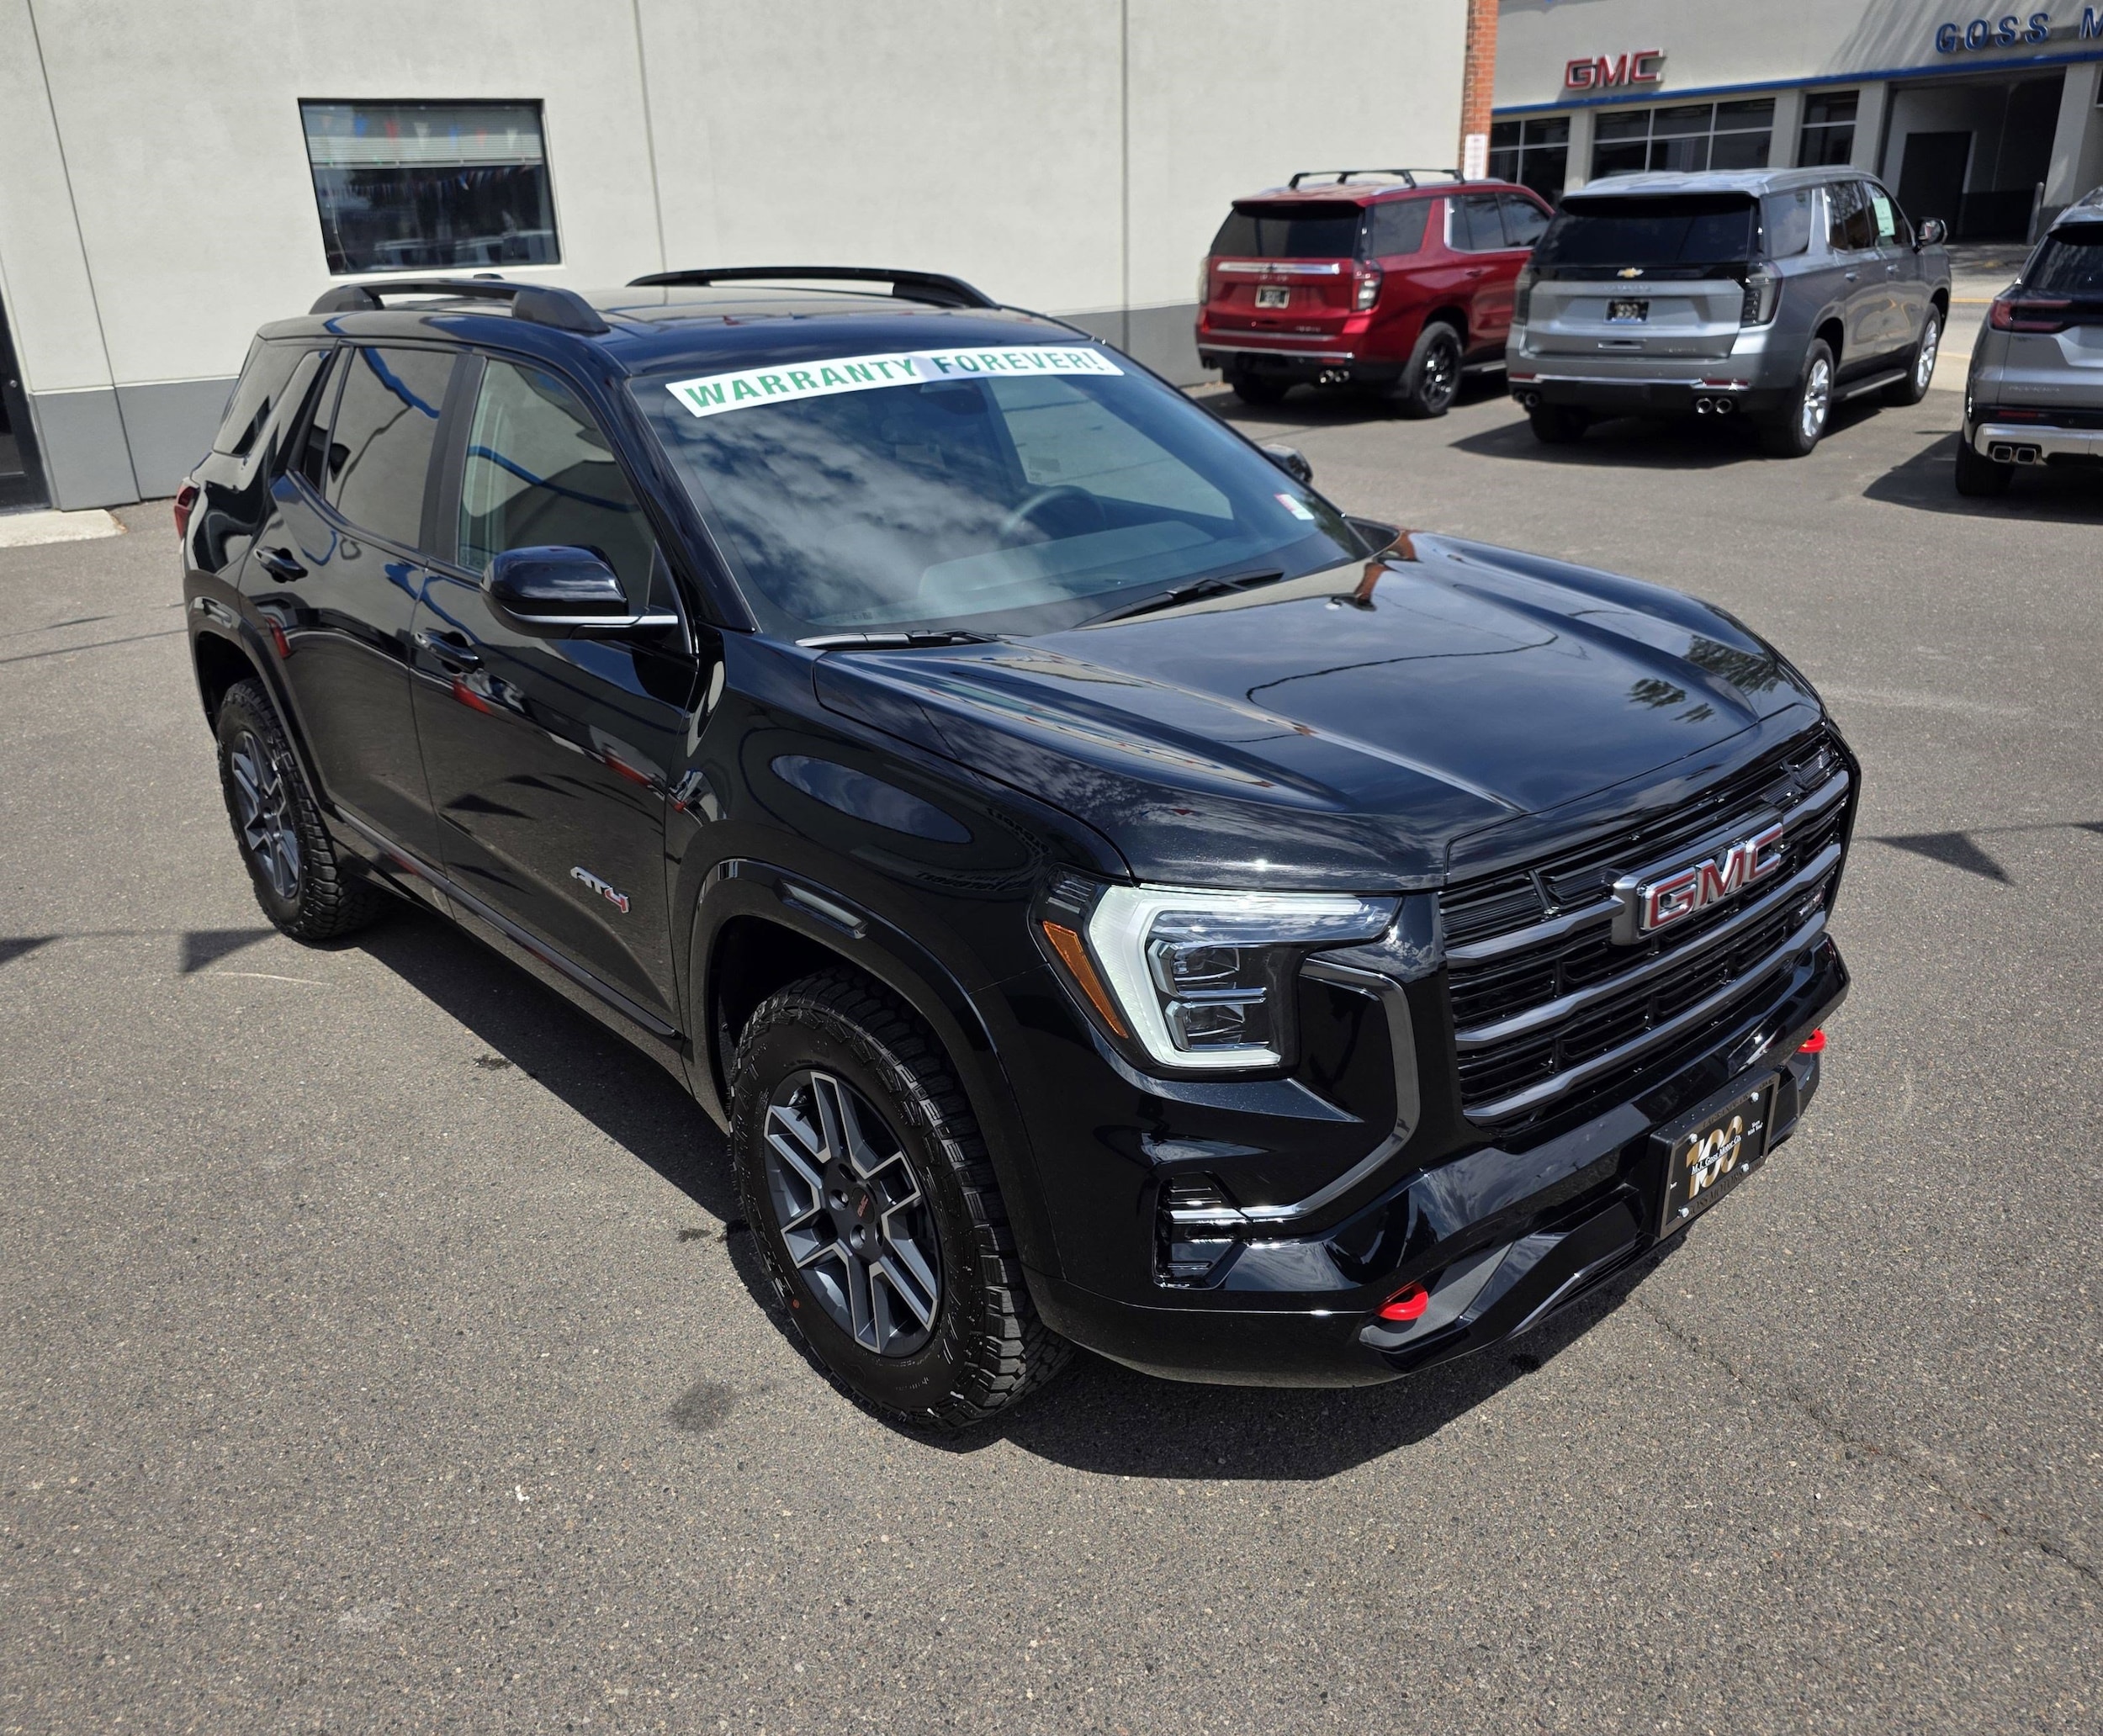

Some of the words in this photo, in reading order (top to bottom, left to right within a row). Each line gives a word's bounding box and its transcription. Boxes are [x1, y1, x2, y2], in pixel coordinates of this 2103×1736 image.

[1936, 12, 2050, 54] GOSS
[1565, 47, 1664, 90] GMC
[685, 358, 916, 408] WARRANTY
[930, 352, 1104, 375] FOREVER!
[570, 865, 629, 913] AT4
[1643, 822, 1783, 931] GMC
